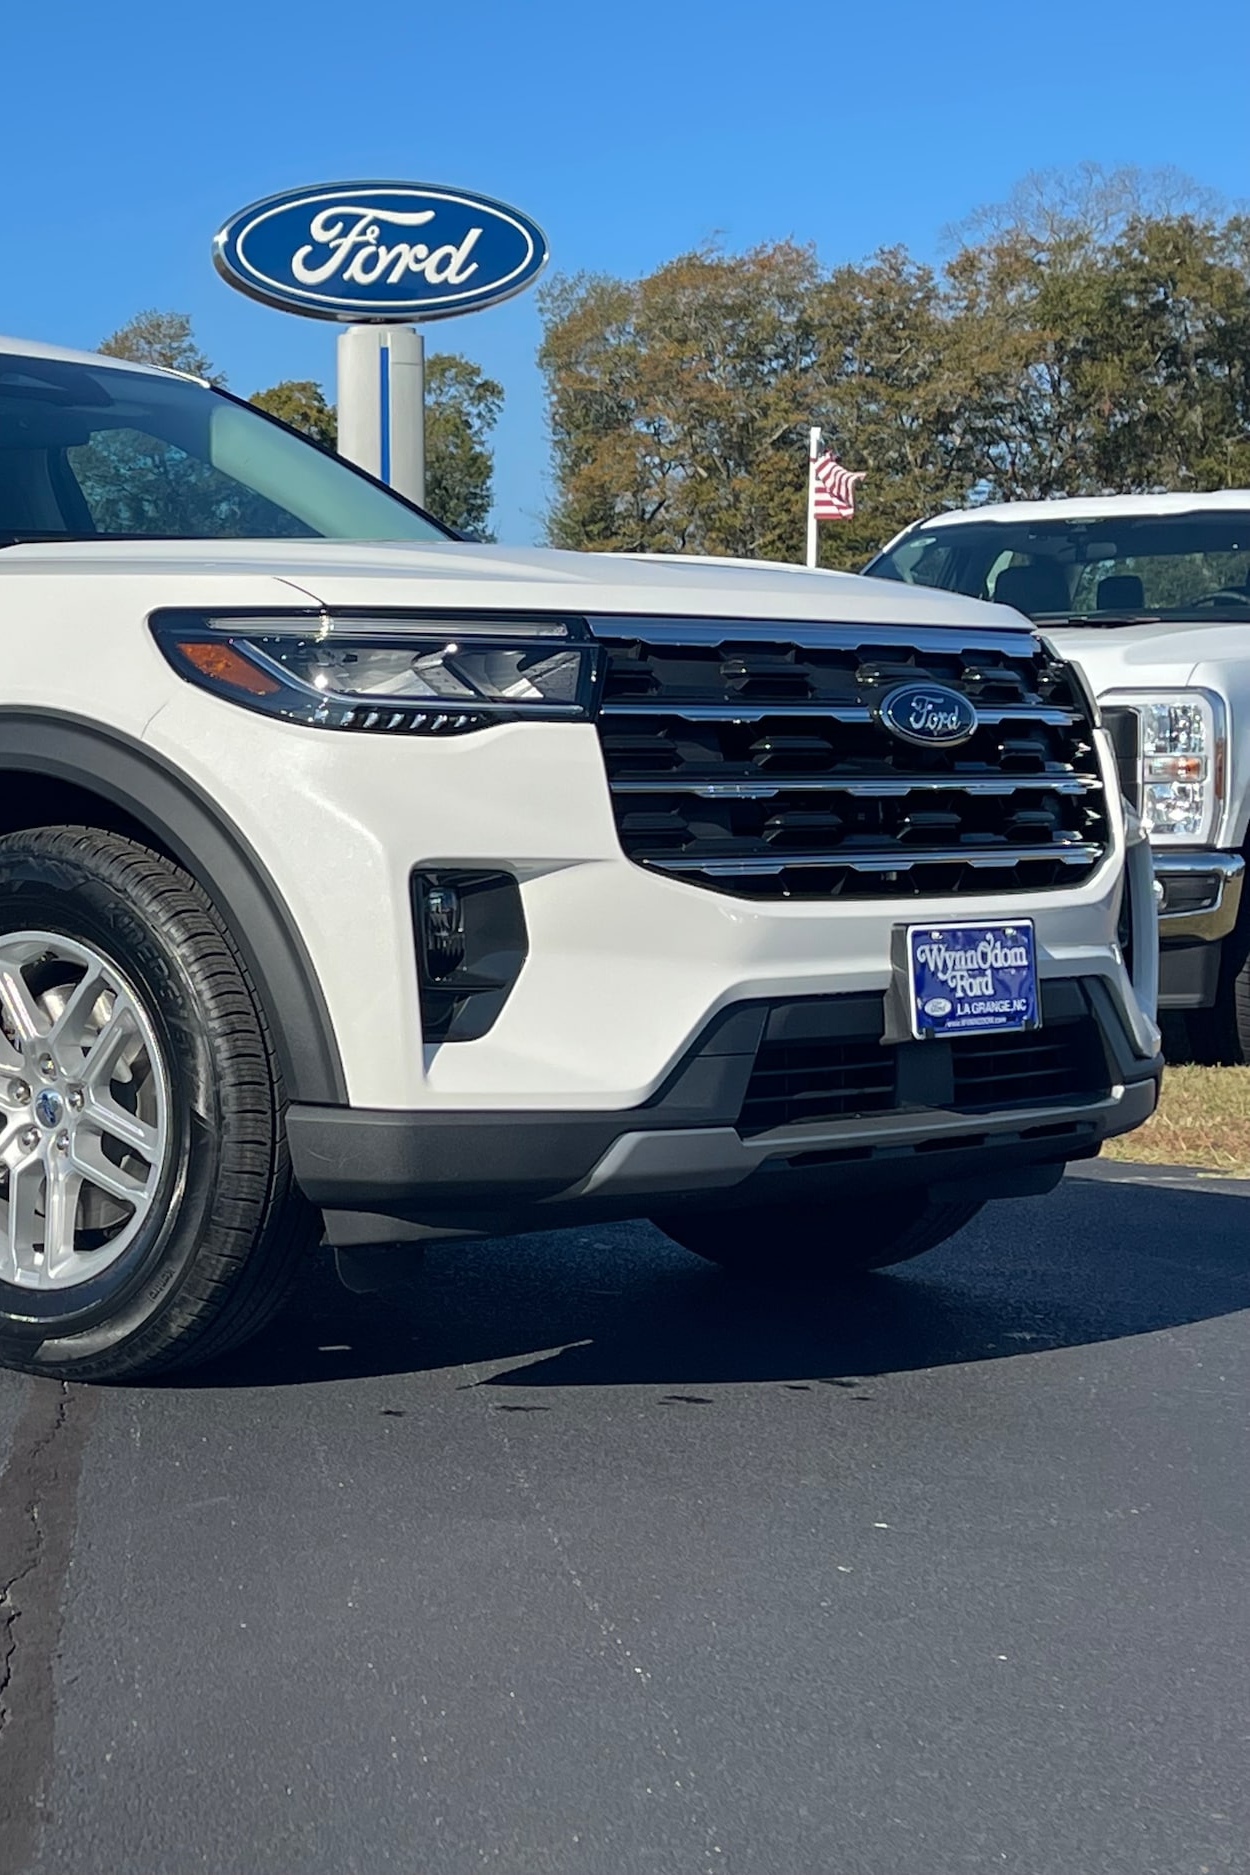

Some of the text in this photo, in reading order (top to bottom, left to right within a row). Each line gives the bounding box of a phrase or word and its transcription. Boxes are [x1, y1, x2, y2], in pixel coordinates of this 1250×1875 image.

[292, 206, 483, 285] Ford
[910, 695, 961, 730] Ford
[947, 968, 994, 998] Ford
[956, 1003, 970, 1016] LA
